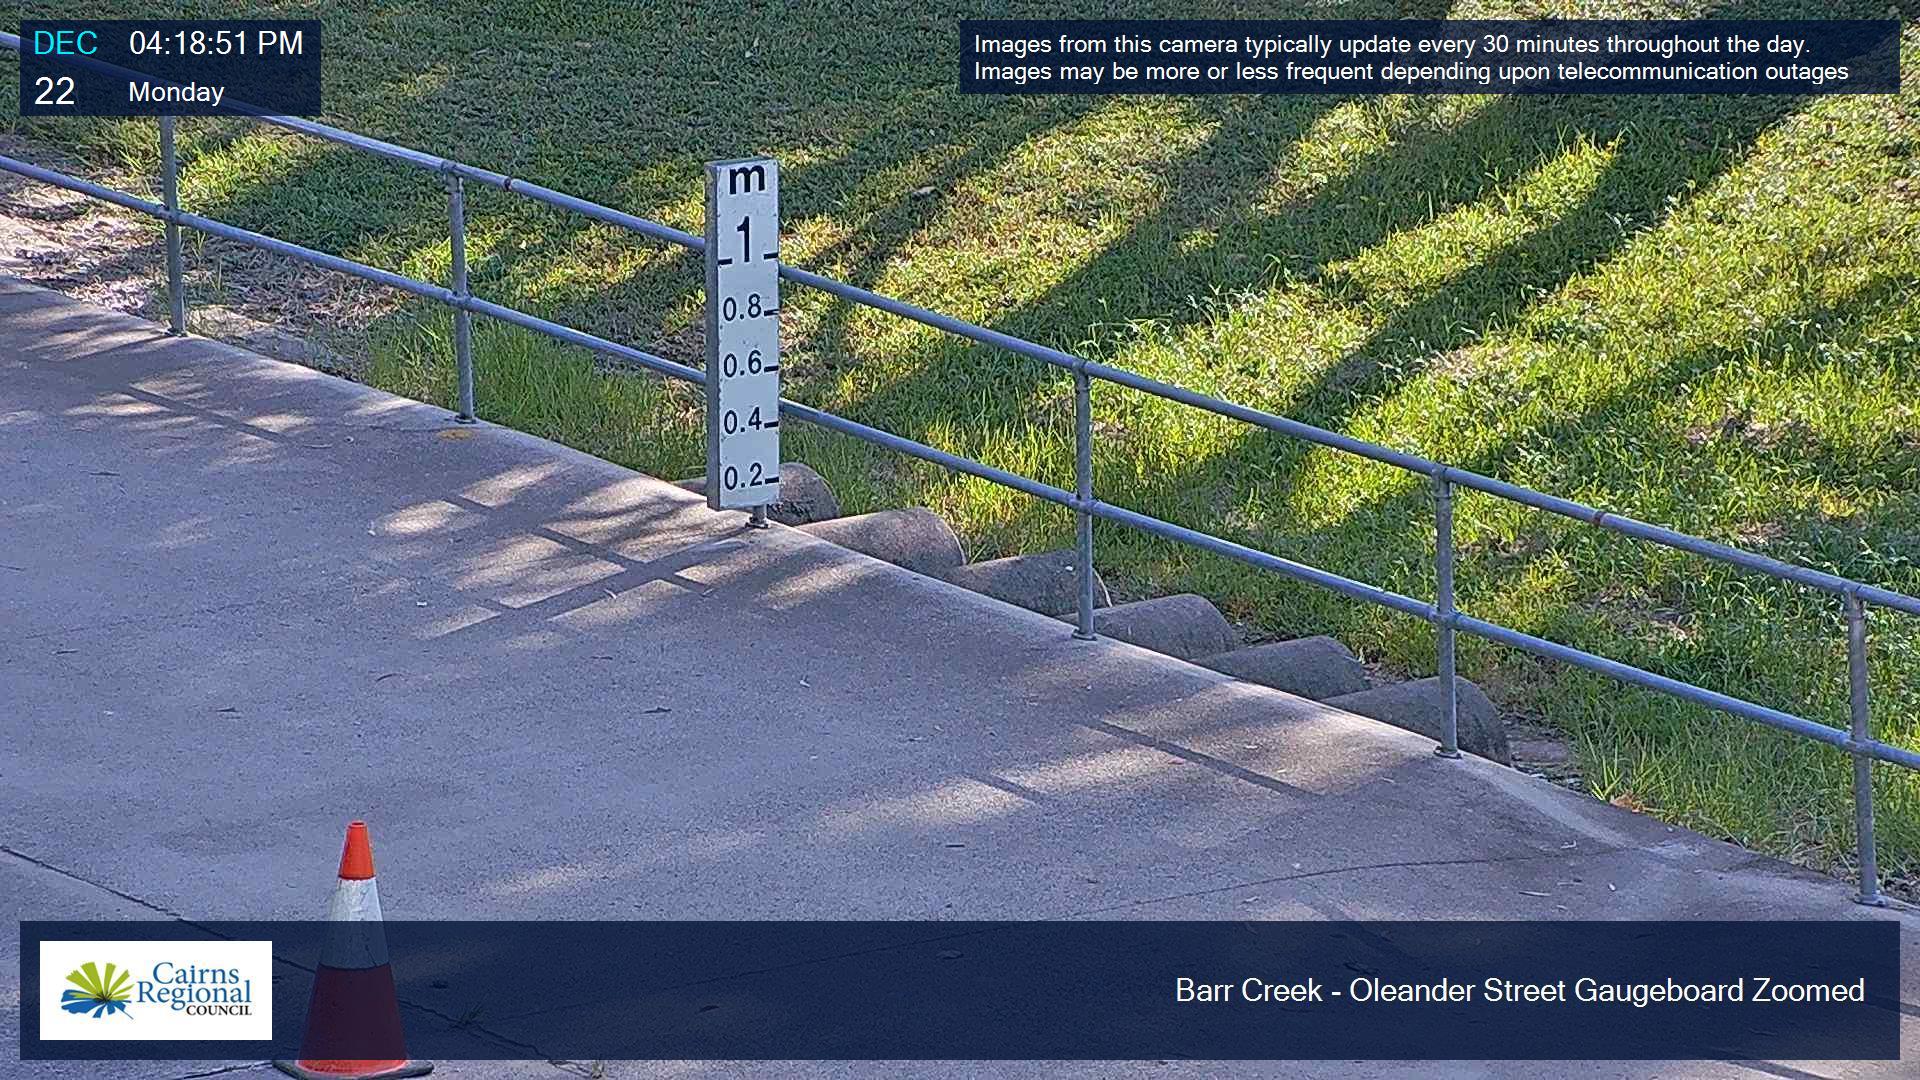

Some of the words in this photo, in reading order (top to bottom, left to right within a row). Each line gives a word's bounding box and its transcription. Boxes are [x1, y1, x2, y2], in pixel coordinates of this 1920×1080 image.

[729, 165, 766, 195] m
[736, 215, 750, 263] 1
[723, 293, 762, 322] 0.8
[723, 349, 762, 378] 0.6
[724, 406, 762, 435] 0.4
[724, 462, 763, 491] 0.2
